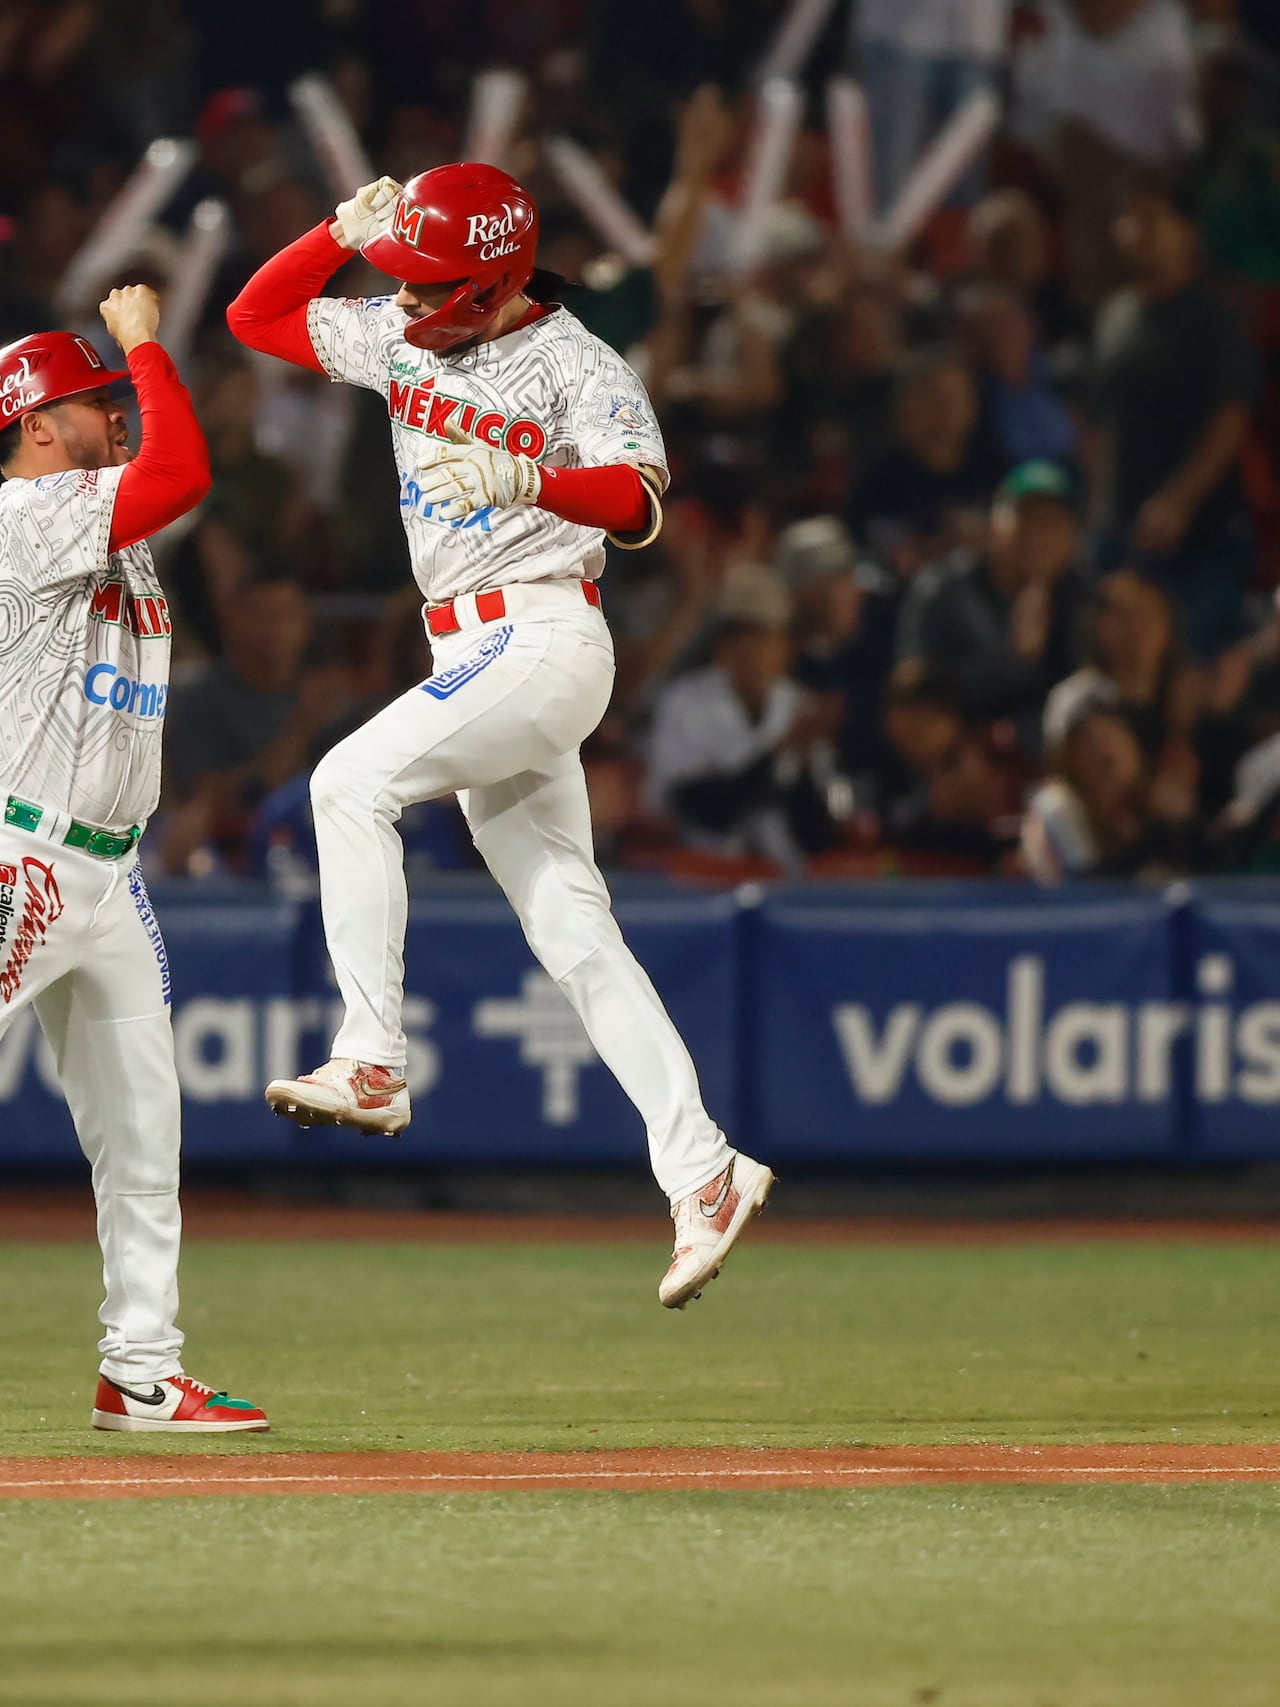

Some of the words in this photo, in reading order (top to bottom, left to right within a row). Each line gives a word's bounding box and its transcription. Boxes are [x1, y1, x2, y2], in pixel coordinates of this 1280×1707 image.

[394, 196, 426, 247] M
[463, 203, 518, 247] Red
[479, 237, 521, 261] Cola
[1, 388, 46, 417] Cola
[832, 954, 1280, 1105] volaris
